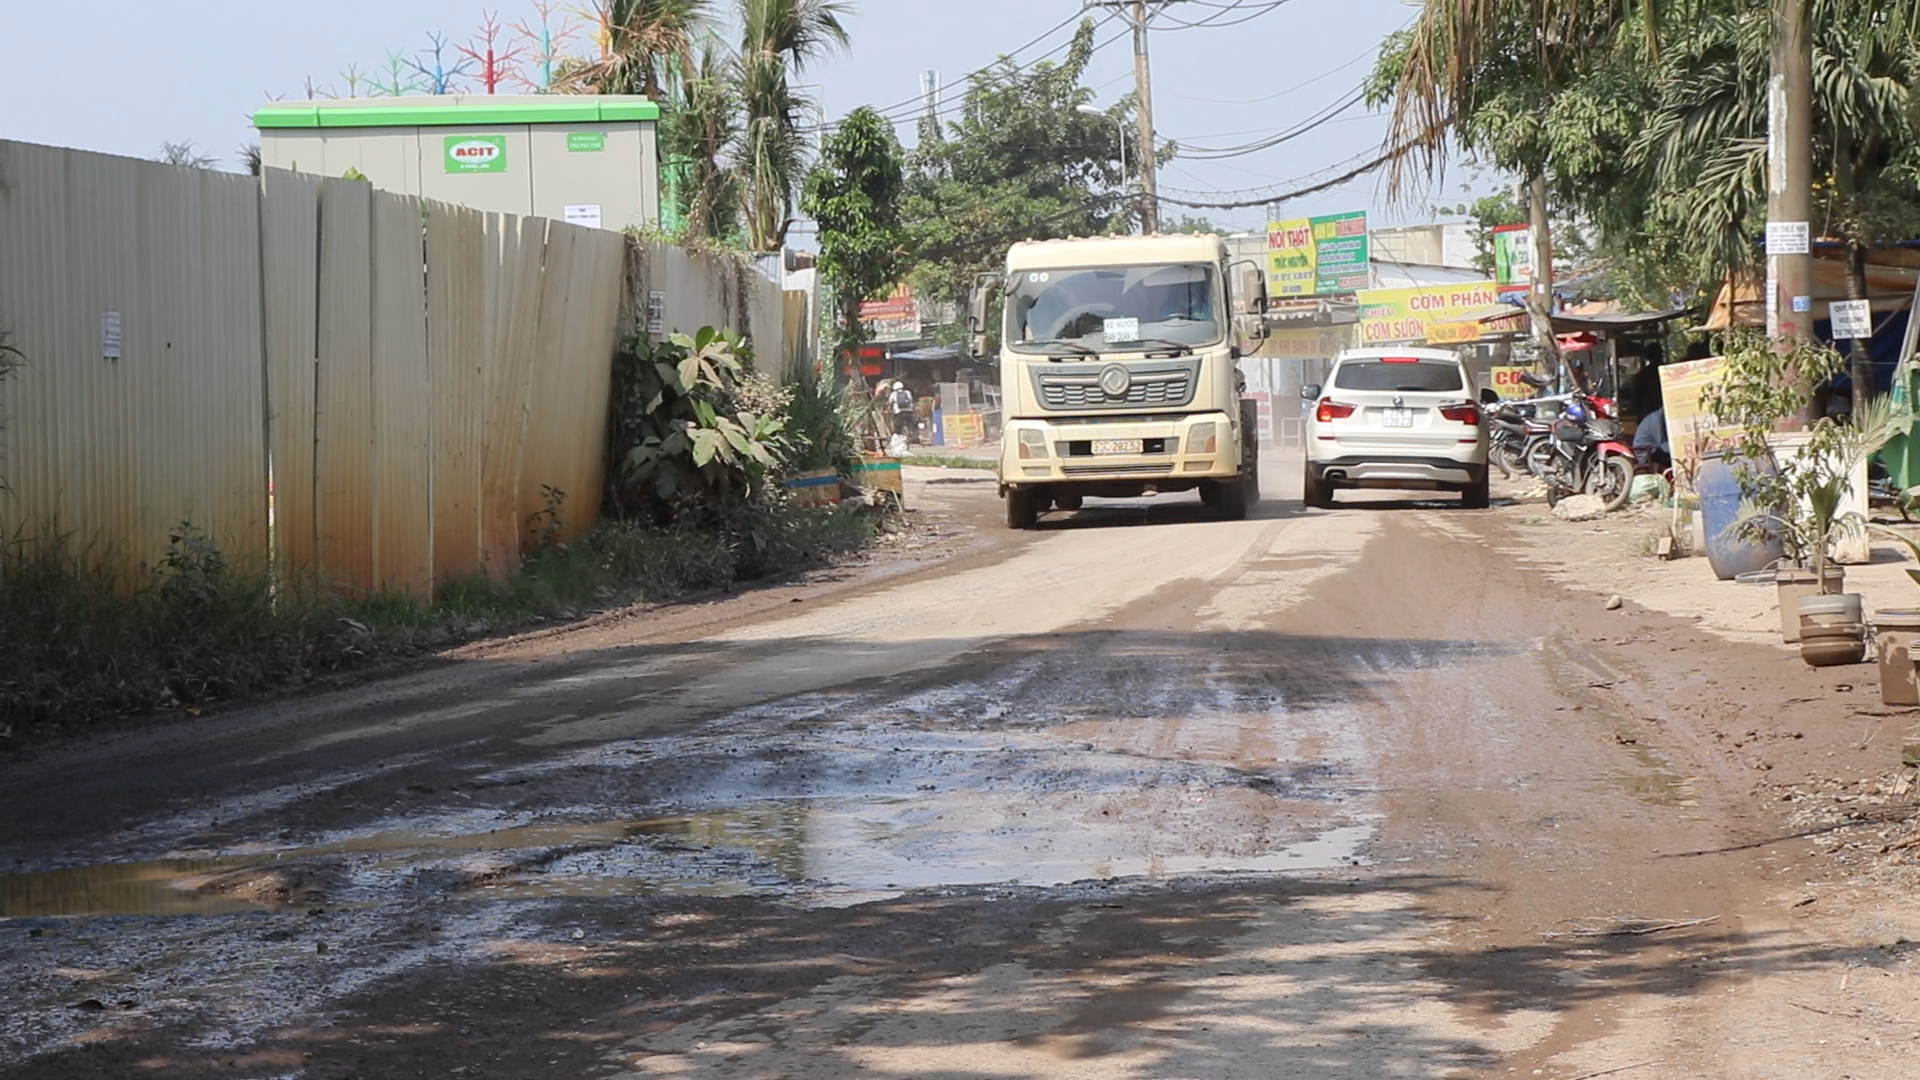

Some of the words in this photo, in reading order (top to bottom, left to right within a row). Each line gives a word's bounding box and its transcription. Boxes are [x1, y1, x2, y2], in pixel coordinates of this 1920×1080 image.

[455, 147, 495, 158] ACIT
[1410, 294, 1445, 309] CƠM
[1366, 321, 1391, 340] CƠM
[1495, 370, 1523, 385] CƠ
